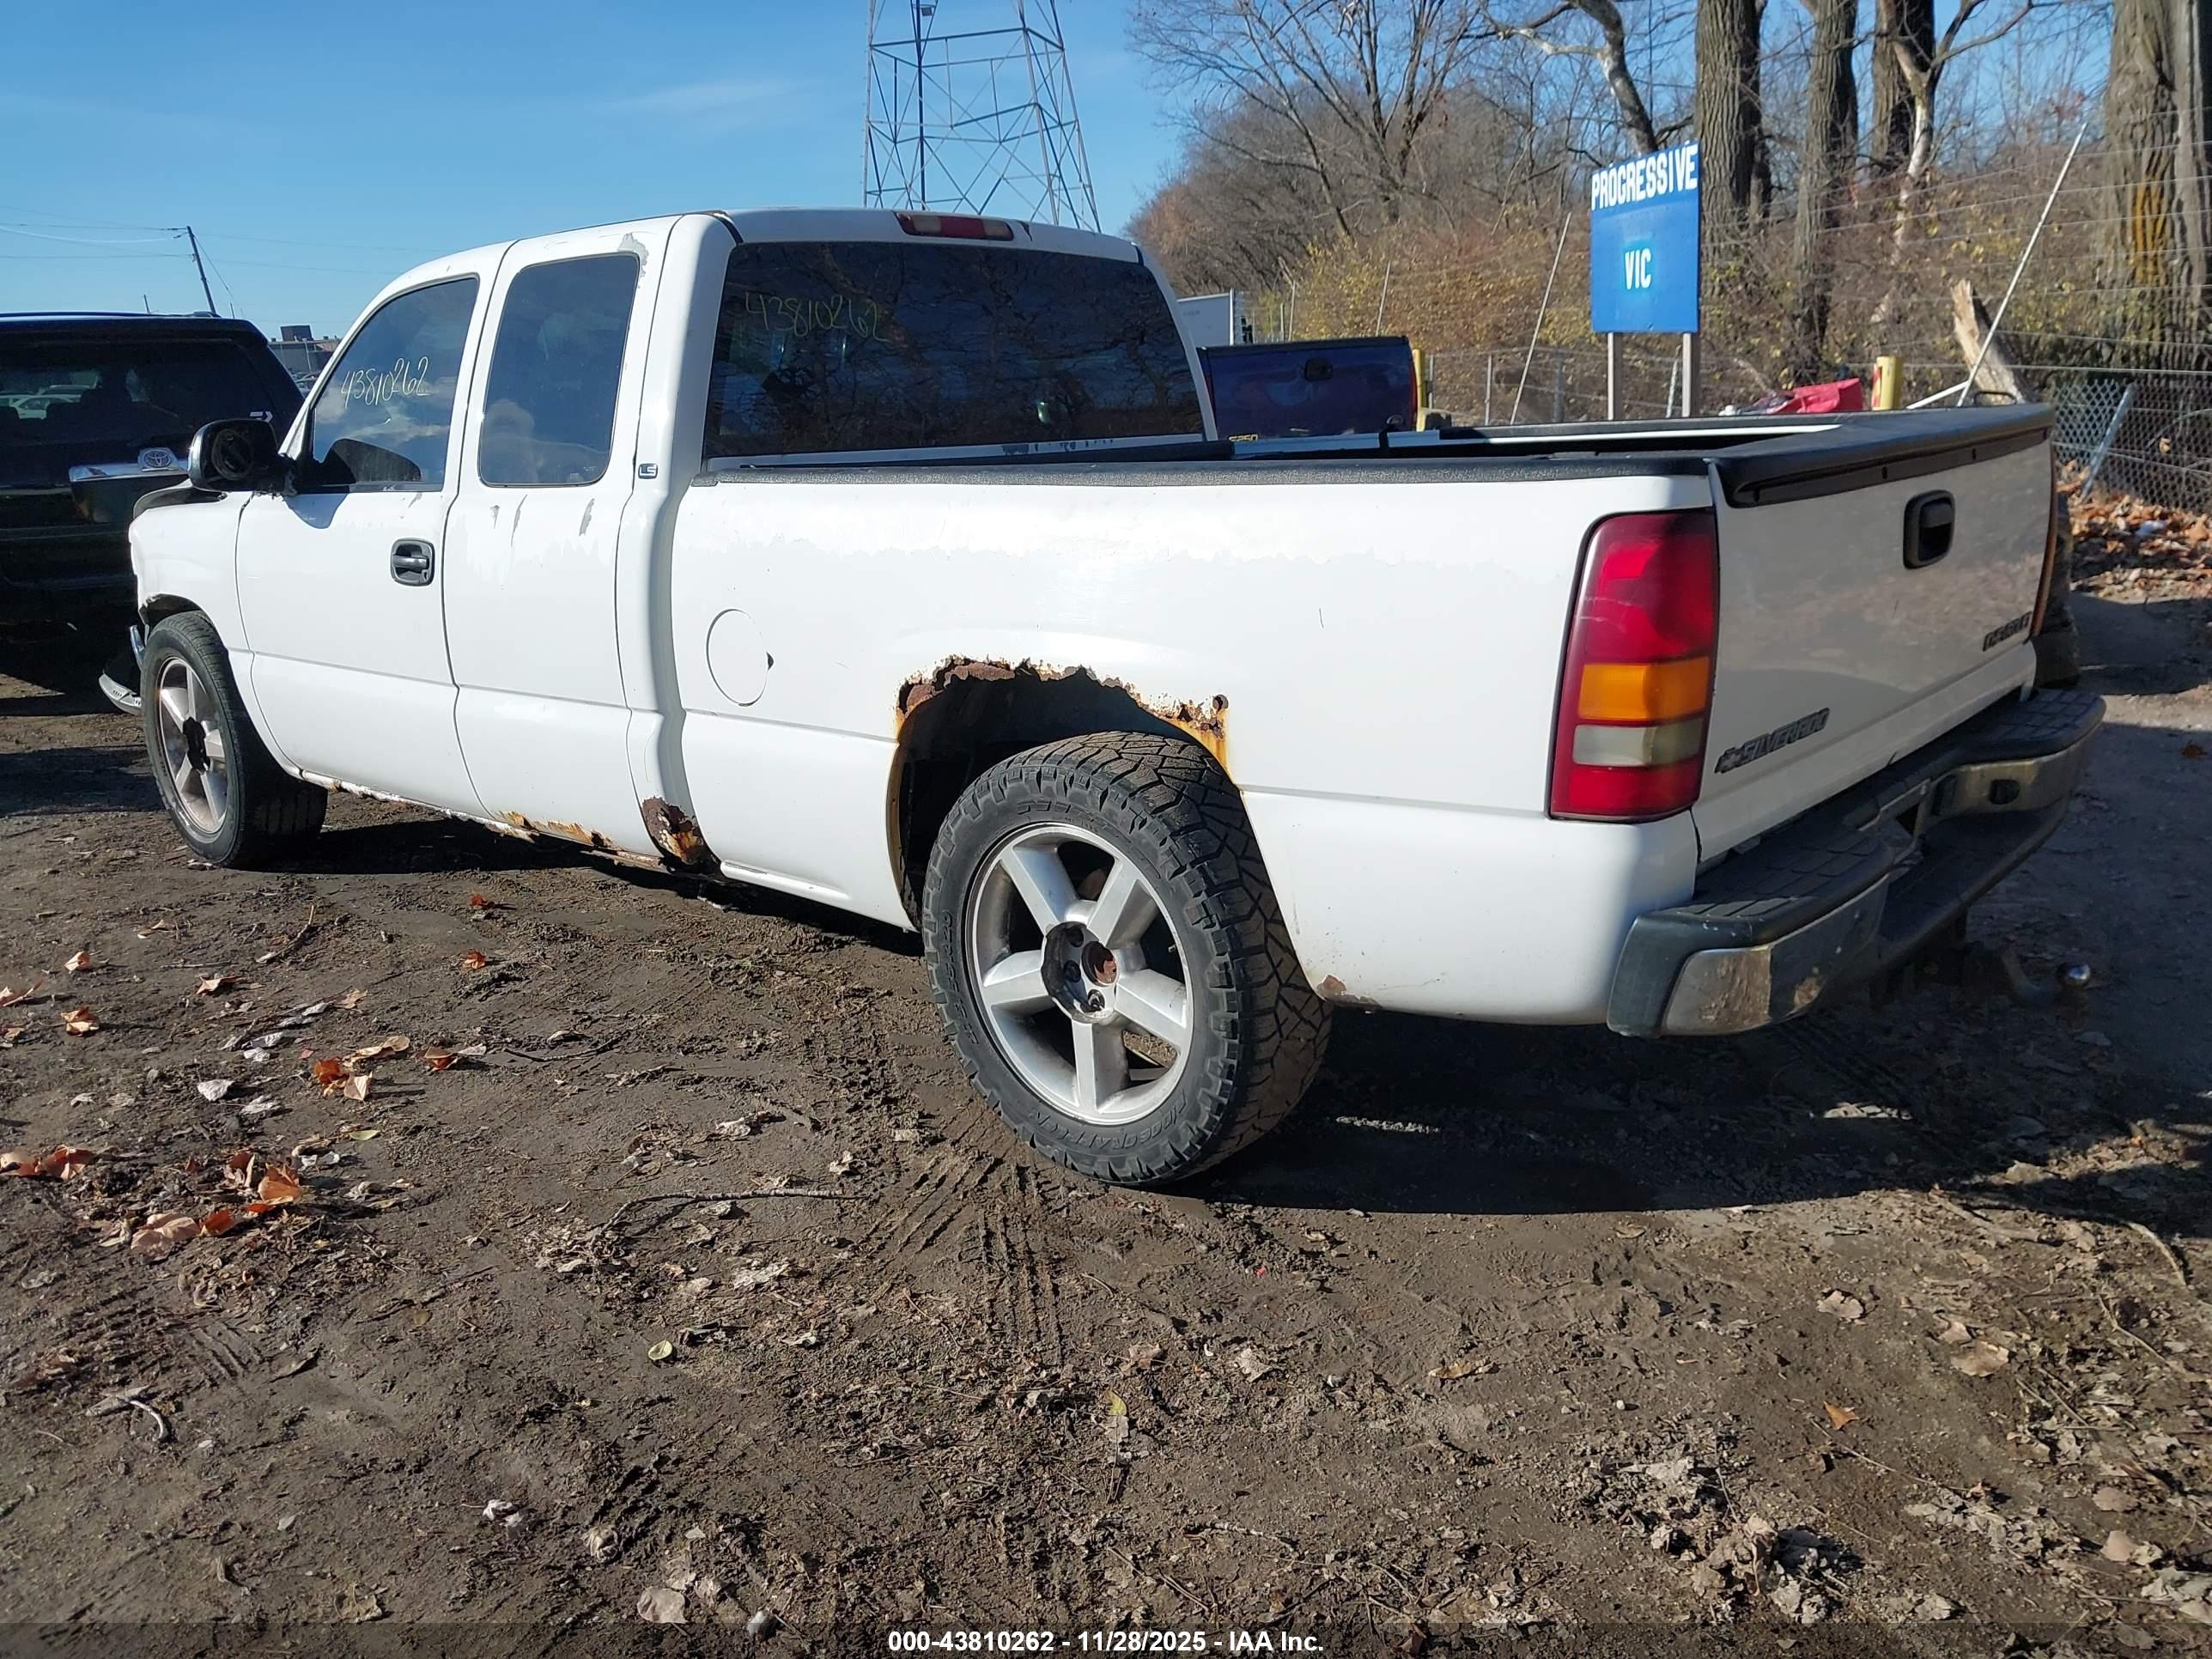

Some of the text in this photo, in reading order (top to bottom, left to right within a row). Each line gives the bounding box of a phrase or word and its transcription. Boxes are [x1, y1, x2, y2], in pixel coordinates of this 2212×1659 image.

[1591, 144, 1698, 210] PROGRESSIVE
[1625, 247, 1652, 290] VIC
[745, 292, 891, 343] 43810262
[341, 356, 431, 410] 43810262
